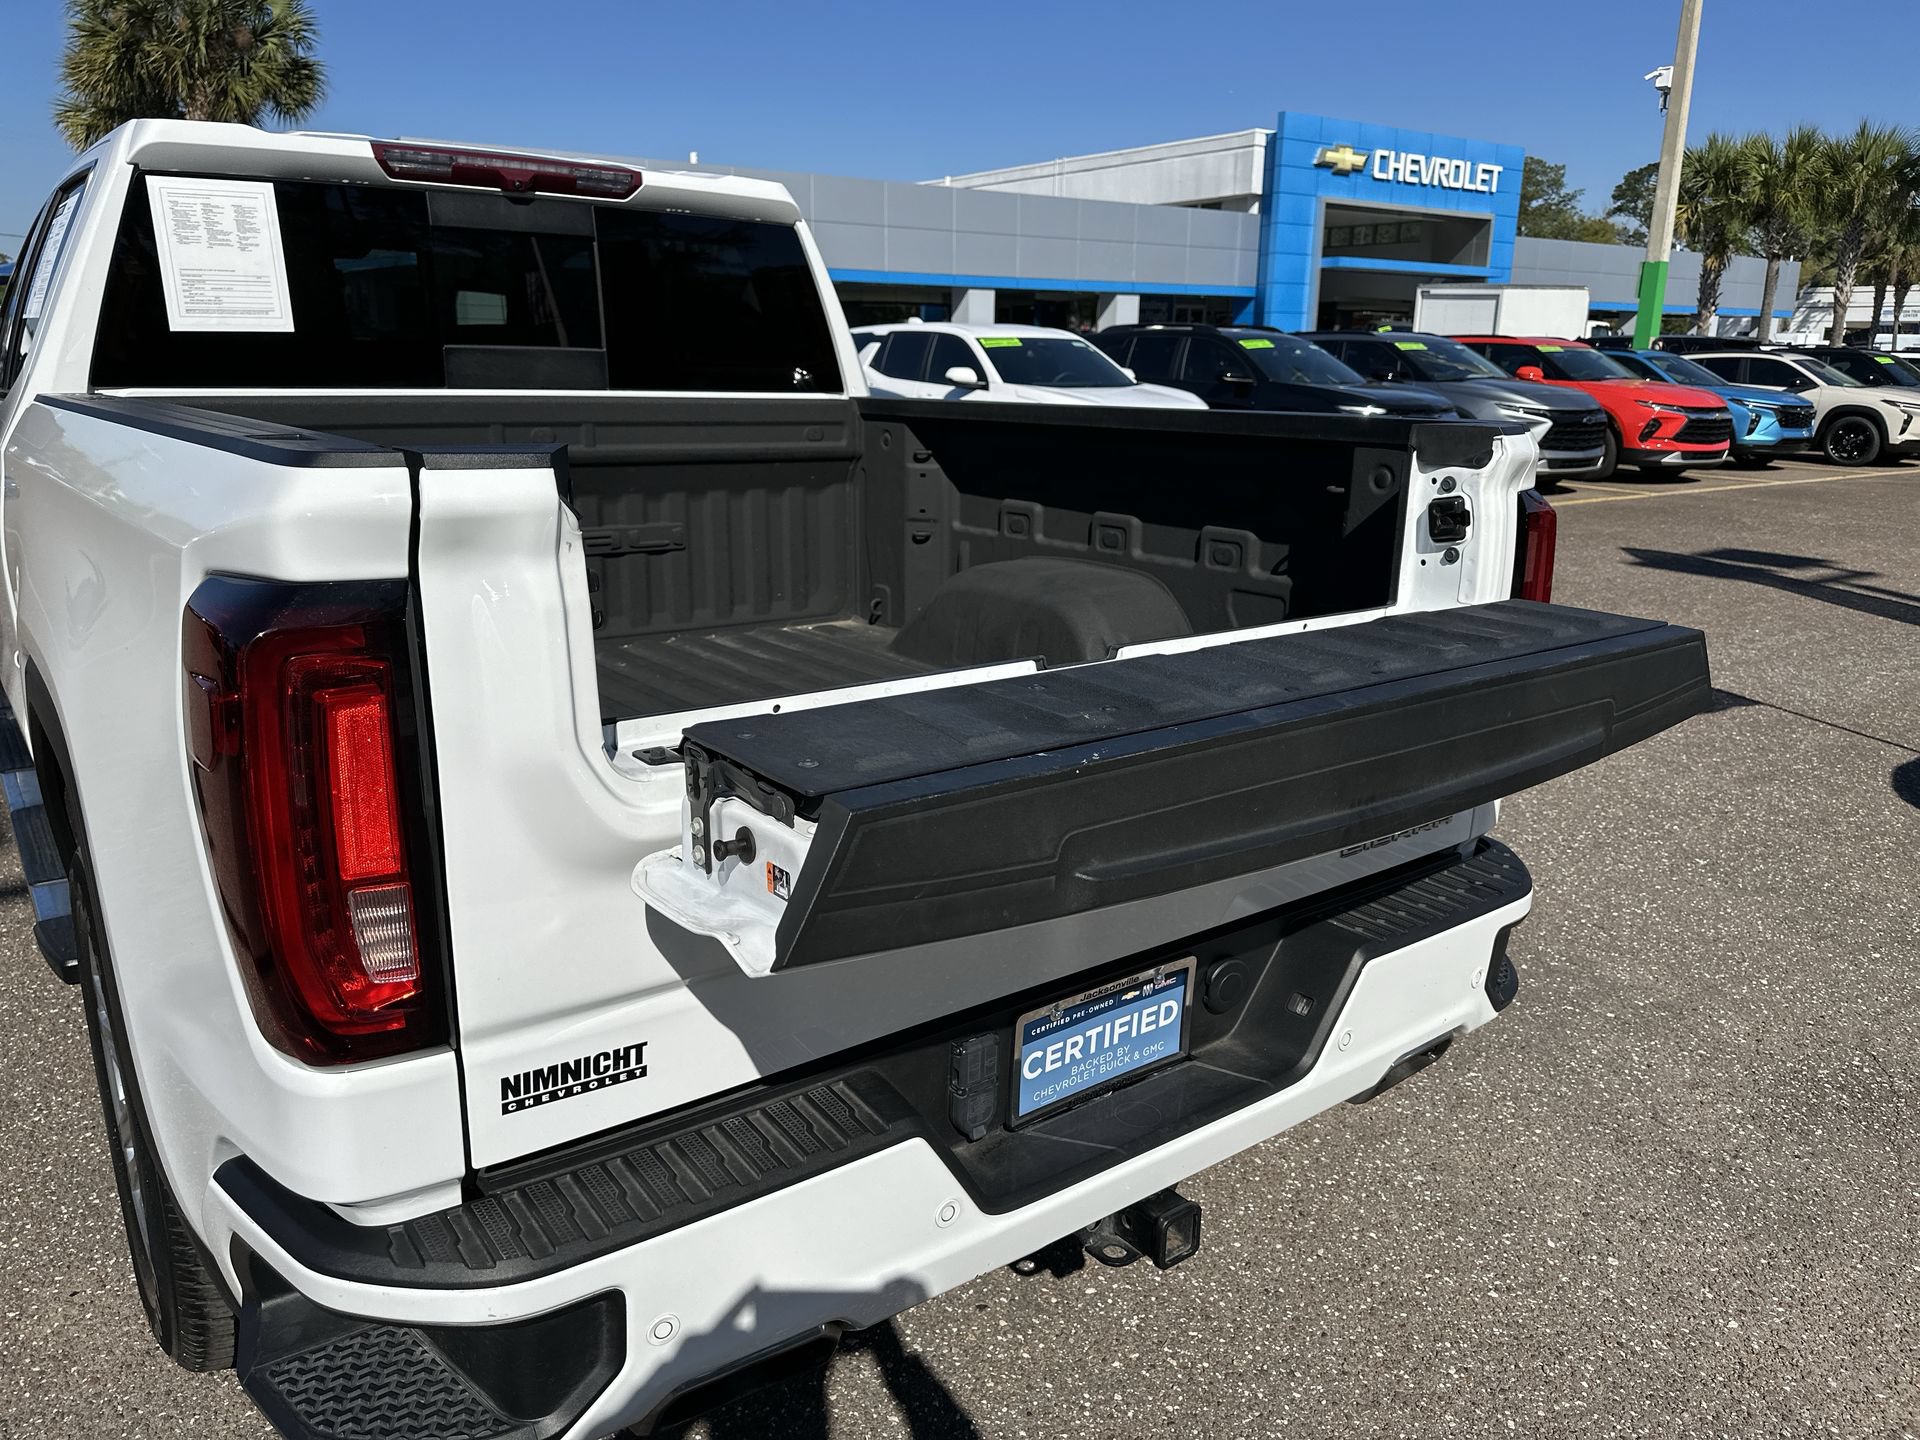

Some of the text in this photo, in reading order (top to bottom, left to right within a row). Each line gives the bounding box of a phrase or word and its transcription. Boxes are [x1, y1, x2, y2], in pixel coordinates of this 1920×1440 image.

[1373, 149, 1503, 193] CHEVROLET
[1080, 975, 1140, 1002] Jacksonville
[1155, 977, 1177, 989] GMC
[1031, 999, 1114, 1036] CERTIFIED PRE-OWNED
[1023, 1000, 1179, 1081] CERTIFIED
[1071, 1045, 1130, 1076] BACKED BY
[500, 1041, 648, 1101] NIMNICHT
[507, 1069, 643, 1111] CHEVROLET
[1033, 1071, 1096, 1102] CHEVROLET
[1099, 1054, 1131, 1074] BUICK
[1133, 1050, 1140, 1060] &
[1143, 1042, 1165, 1056] GMC
